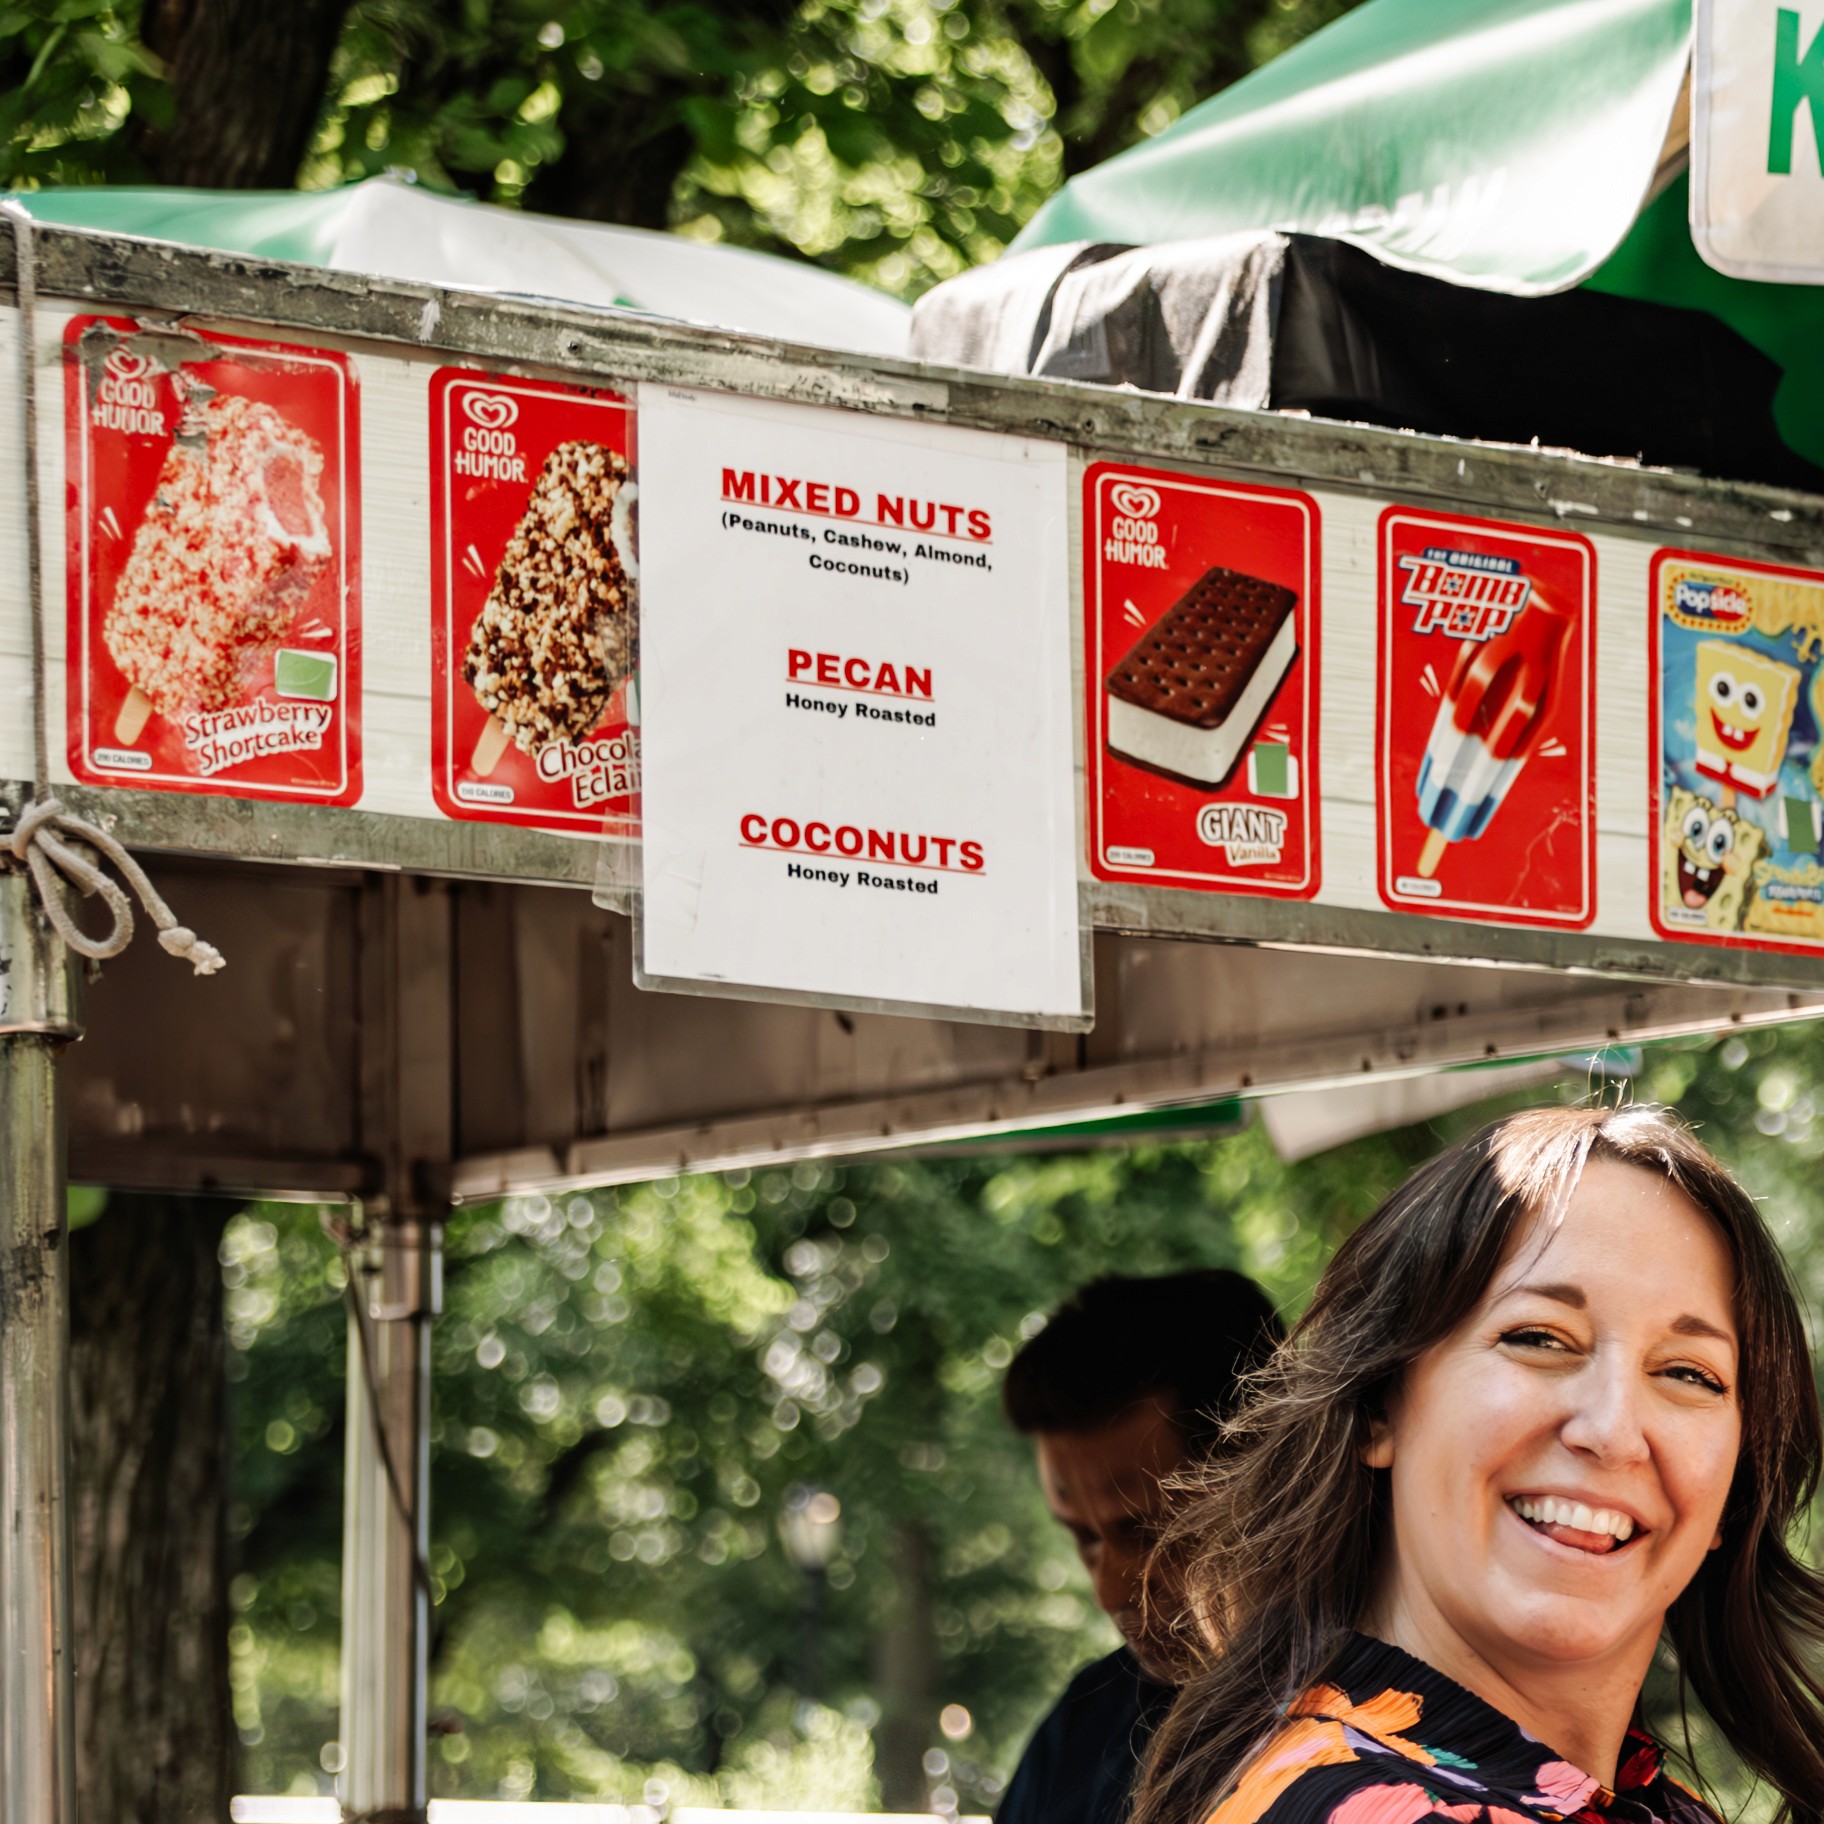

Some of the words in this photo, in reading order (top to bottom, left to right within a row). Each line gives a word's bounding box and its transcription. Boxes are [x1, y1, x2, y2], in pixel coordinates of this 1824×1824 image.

[100, 378, 156, 409] GOOD
[464, 426, 516, 456] GOOD
[721, 467, 860, 517] MIXED
[877, 494, 993, 541] NUTS
[721, 512, 817, 543] (Peanuts,
[823, 529, 908, 558] Cashew,
[914, 543, 993, 571] Almond,
[1112, 516, 1159, 546] GOOD
[808, 554, 910, 584] Coconuts)
[787, 648, 933, 698] PECAN
[184, 697, 330, 745] Strawberry
[785, 692, 849, 719] Honey
[855, 702, 937, 728] Roasted
[200, 725, 318, 771] Shortcake
[739, 813, 985, 872] COCONUTS
[1201, 807, 1284, 844] GIANT
[787, 862, 850, 888] Honey
[857, 871, 940, 895] Roasted
